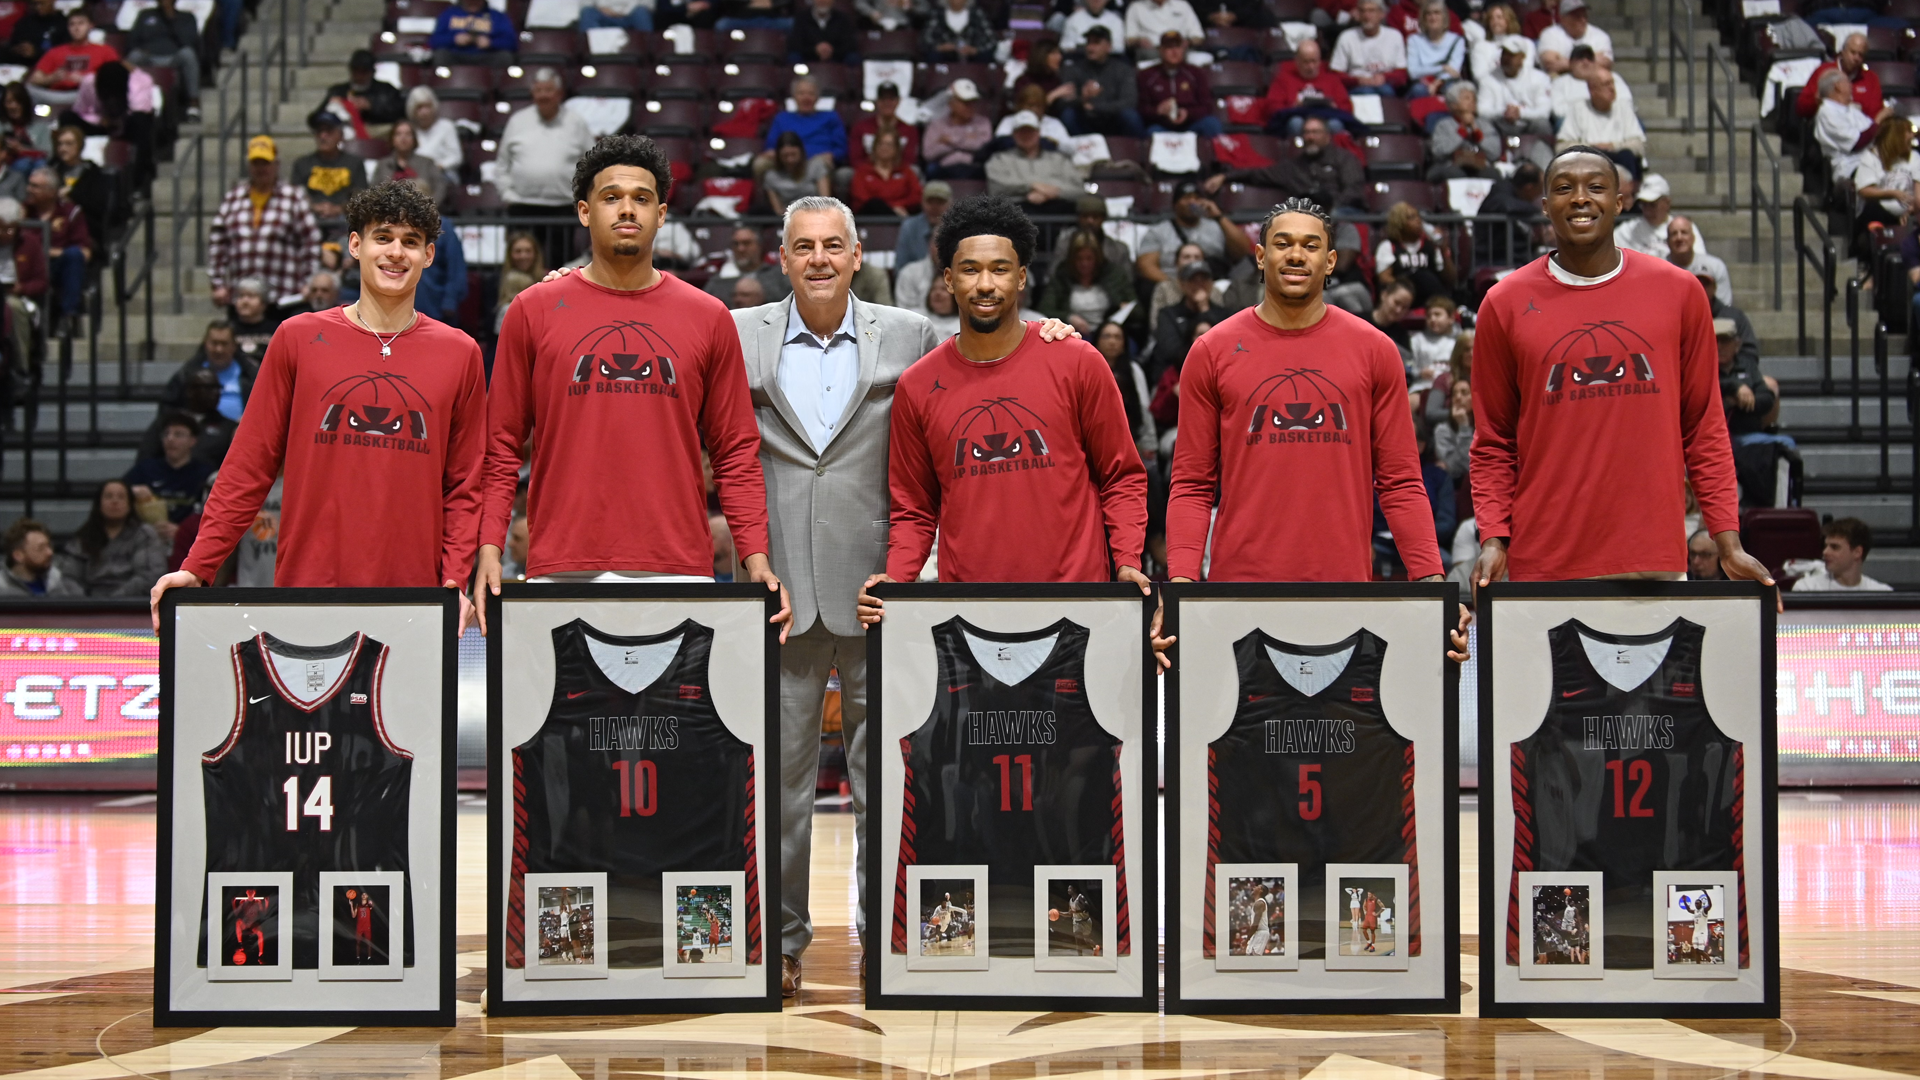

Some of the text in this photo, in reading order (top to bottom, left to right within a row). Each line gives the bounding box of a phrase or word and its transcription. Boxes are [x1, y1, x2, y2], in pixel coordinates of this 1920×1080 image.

[568, 381, 680, 399] IUP BASKETBAL
[1569, 382, 1660, 401] BASKETBALL
[314, 432, 431, 455] IUP BASKETBALL
[970, 457, 1056, 476] BASKETBALL
[3, 674, 160, 720] ETZ
[589, 716, 679, 751] HAWKS
[968, 710, 1057, 745] HAWKS
[1264, 719, 1356, 754] HAWKS
[1583, 715, 1674, 750] HAWKS
[285, 731, 332, 764] IUP
[612, 759, 658, 817] 10
[992, 754, 1033, 812] 11
[1298, 763, 1322, 821] 5
[1605, 759, 1654, 818] 12
[282, 775, 334, 832] 14
